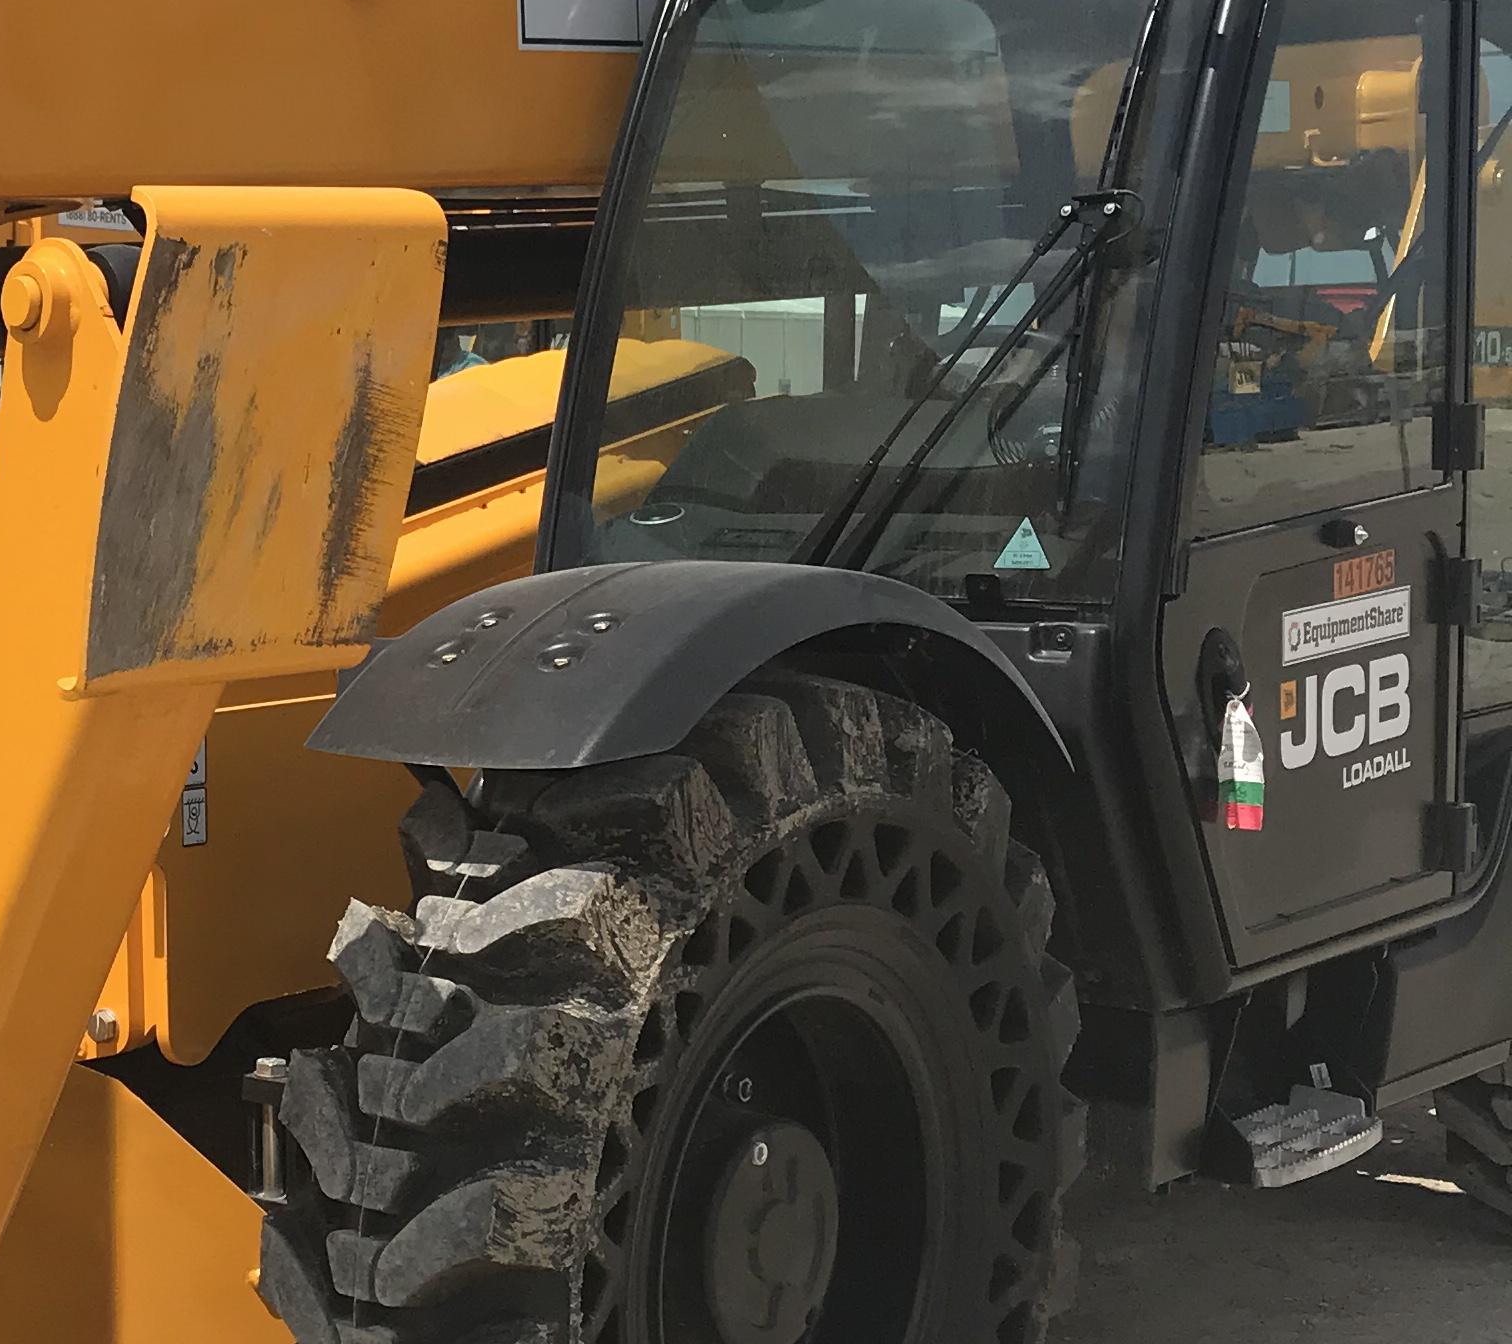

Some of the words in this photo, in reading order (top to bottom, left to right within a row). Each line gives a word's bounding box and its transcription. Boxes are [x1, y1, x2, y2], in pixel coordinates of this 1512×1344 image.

[1336, 550, 1394, 594] 141765
[1303, 605, 1404, 647] EquipmentShare
[1280, 653, 1411, 770] JCB
[1342, 747, 1412, 789] LOADALL
